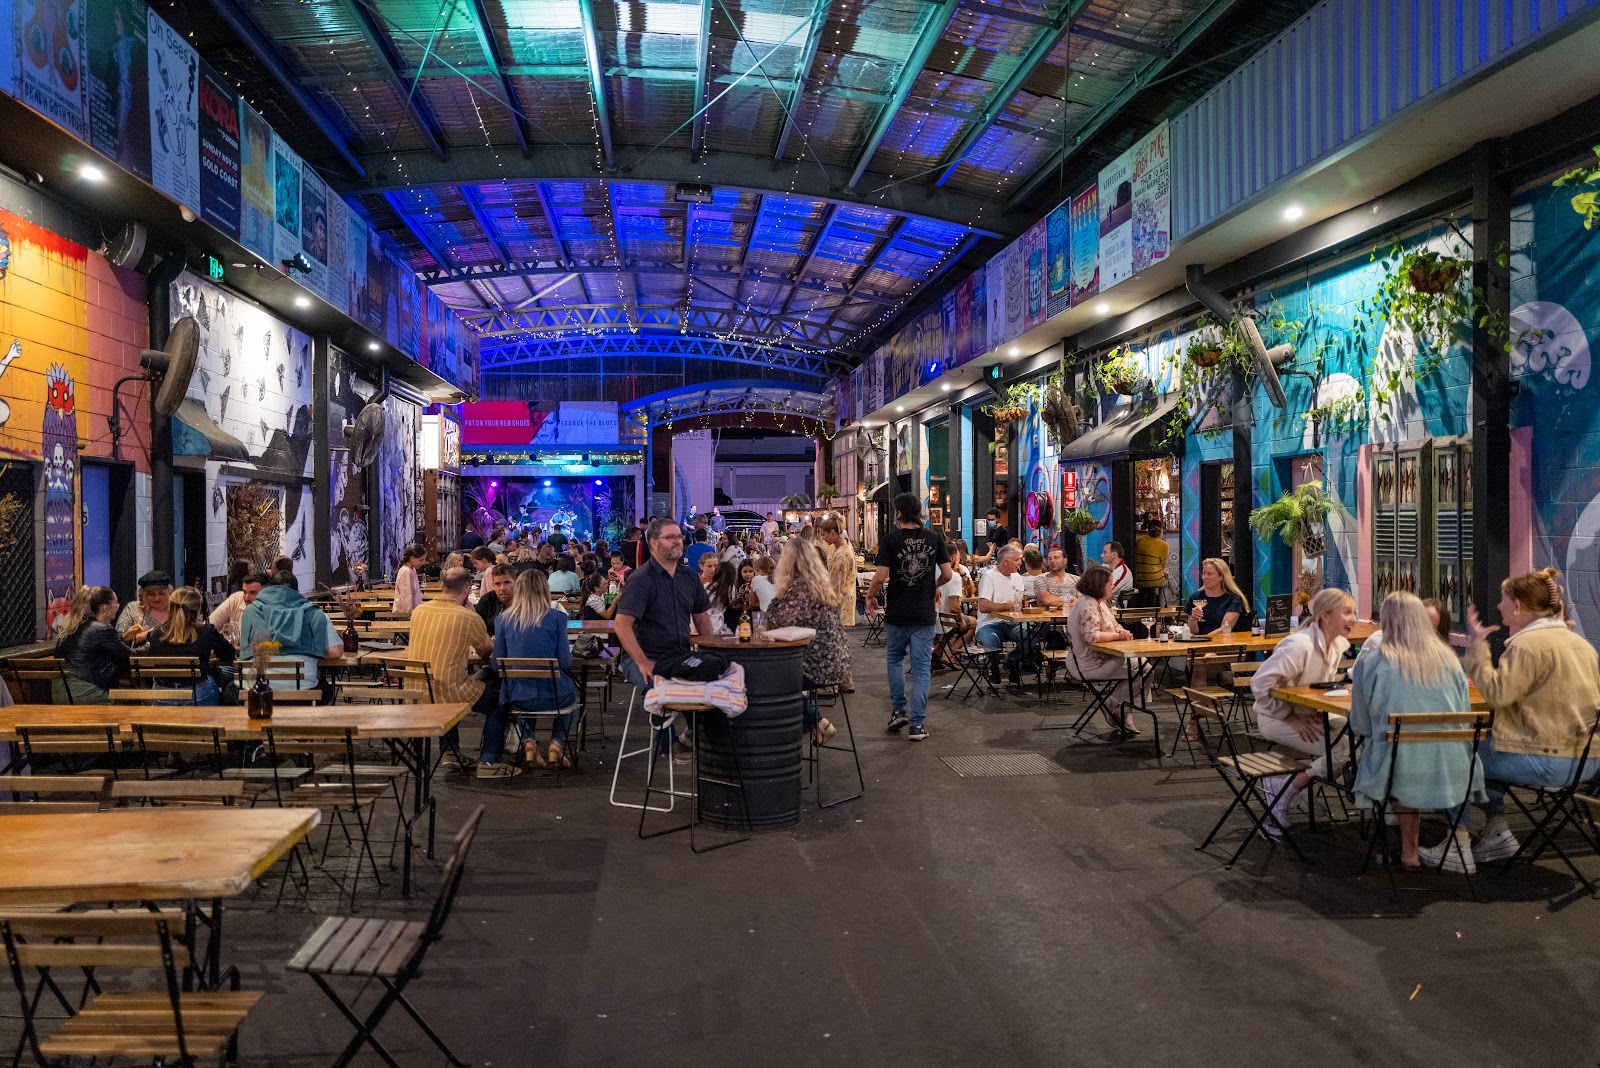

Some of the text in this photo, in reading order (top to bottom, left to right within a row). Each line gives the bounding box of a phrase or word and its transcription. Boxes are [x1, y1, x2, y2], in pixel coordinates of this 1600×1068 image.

[149, 13, 164, 41] Oh
[166, 28, 189, 65] Sees
[202, 138, 222, 161] SUNDAY
[1132, 152, 1148, 182] JOSH
[1149, 127, 1165, 163] PYKE
[202, 154, 219, 176] GOLD
[219, 165, 239, 190] COAST
[1159, 162, 1170, 174] AUG
[1146, 172, 1170, 192] MARKETTA
[1157, 178, 1170, 191] GOLD
[1072, 189, 1097, 217] OCEAN
[1154, 186, 1170, 200] COAST
[1073, 204, 1098, 235] ALLEY
[464, 419, 530, 427] PUT ON YOUR RED SHOES
[599, 419, 617, 427] BLUES
